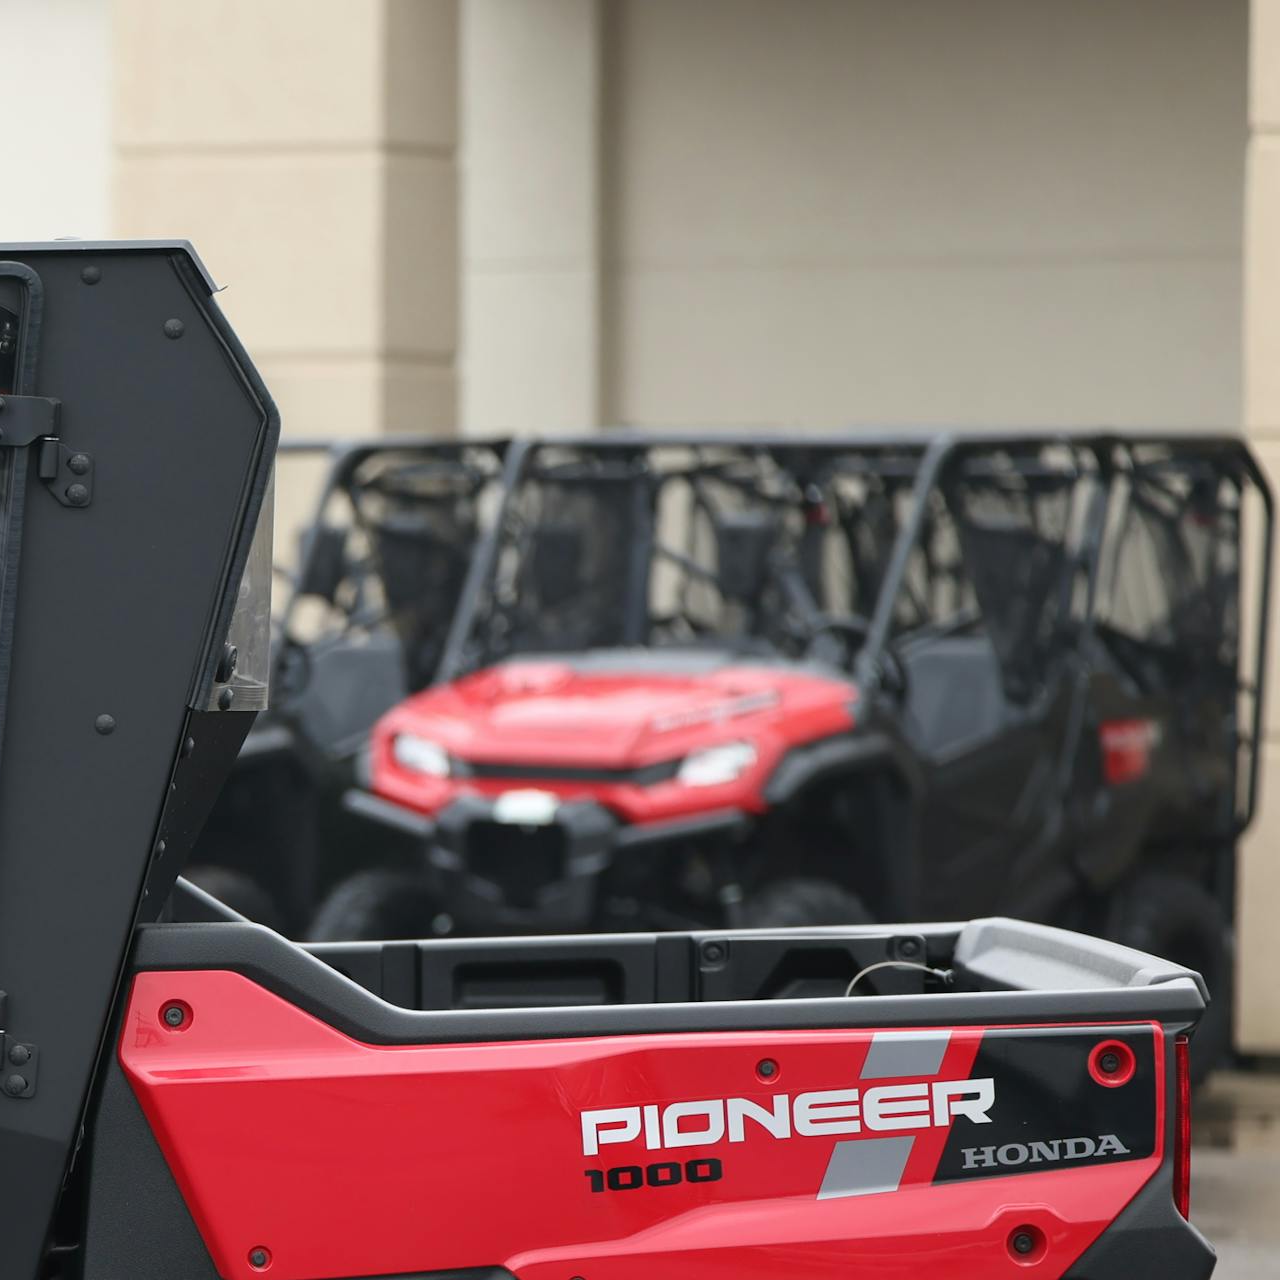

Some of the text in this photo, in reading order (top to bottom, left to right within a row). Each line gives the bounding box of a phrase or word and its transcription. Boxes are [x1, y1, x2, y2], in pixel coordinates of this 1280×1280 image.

[581, 1078, 995, 1156] PIONEER
[961, 1134, 1130, 1169] HONDA
[583, 1157, 724, 1193] 1000
